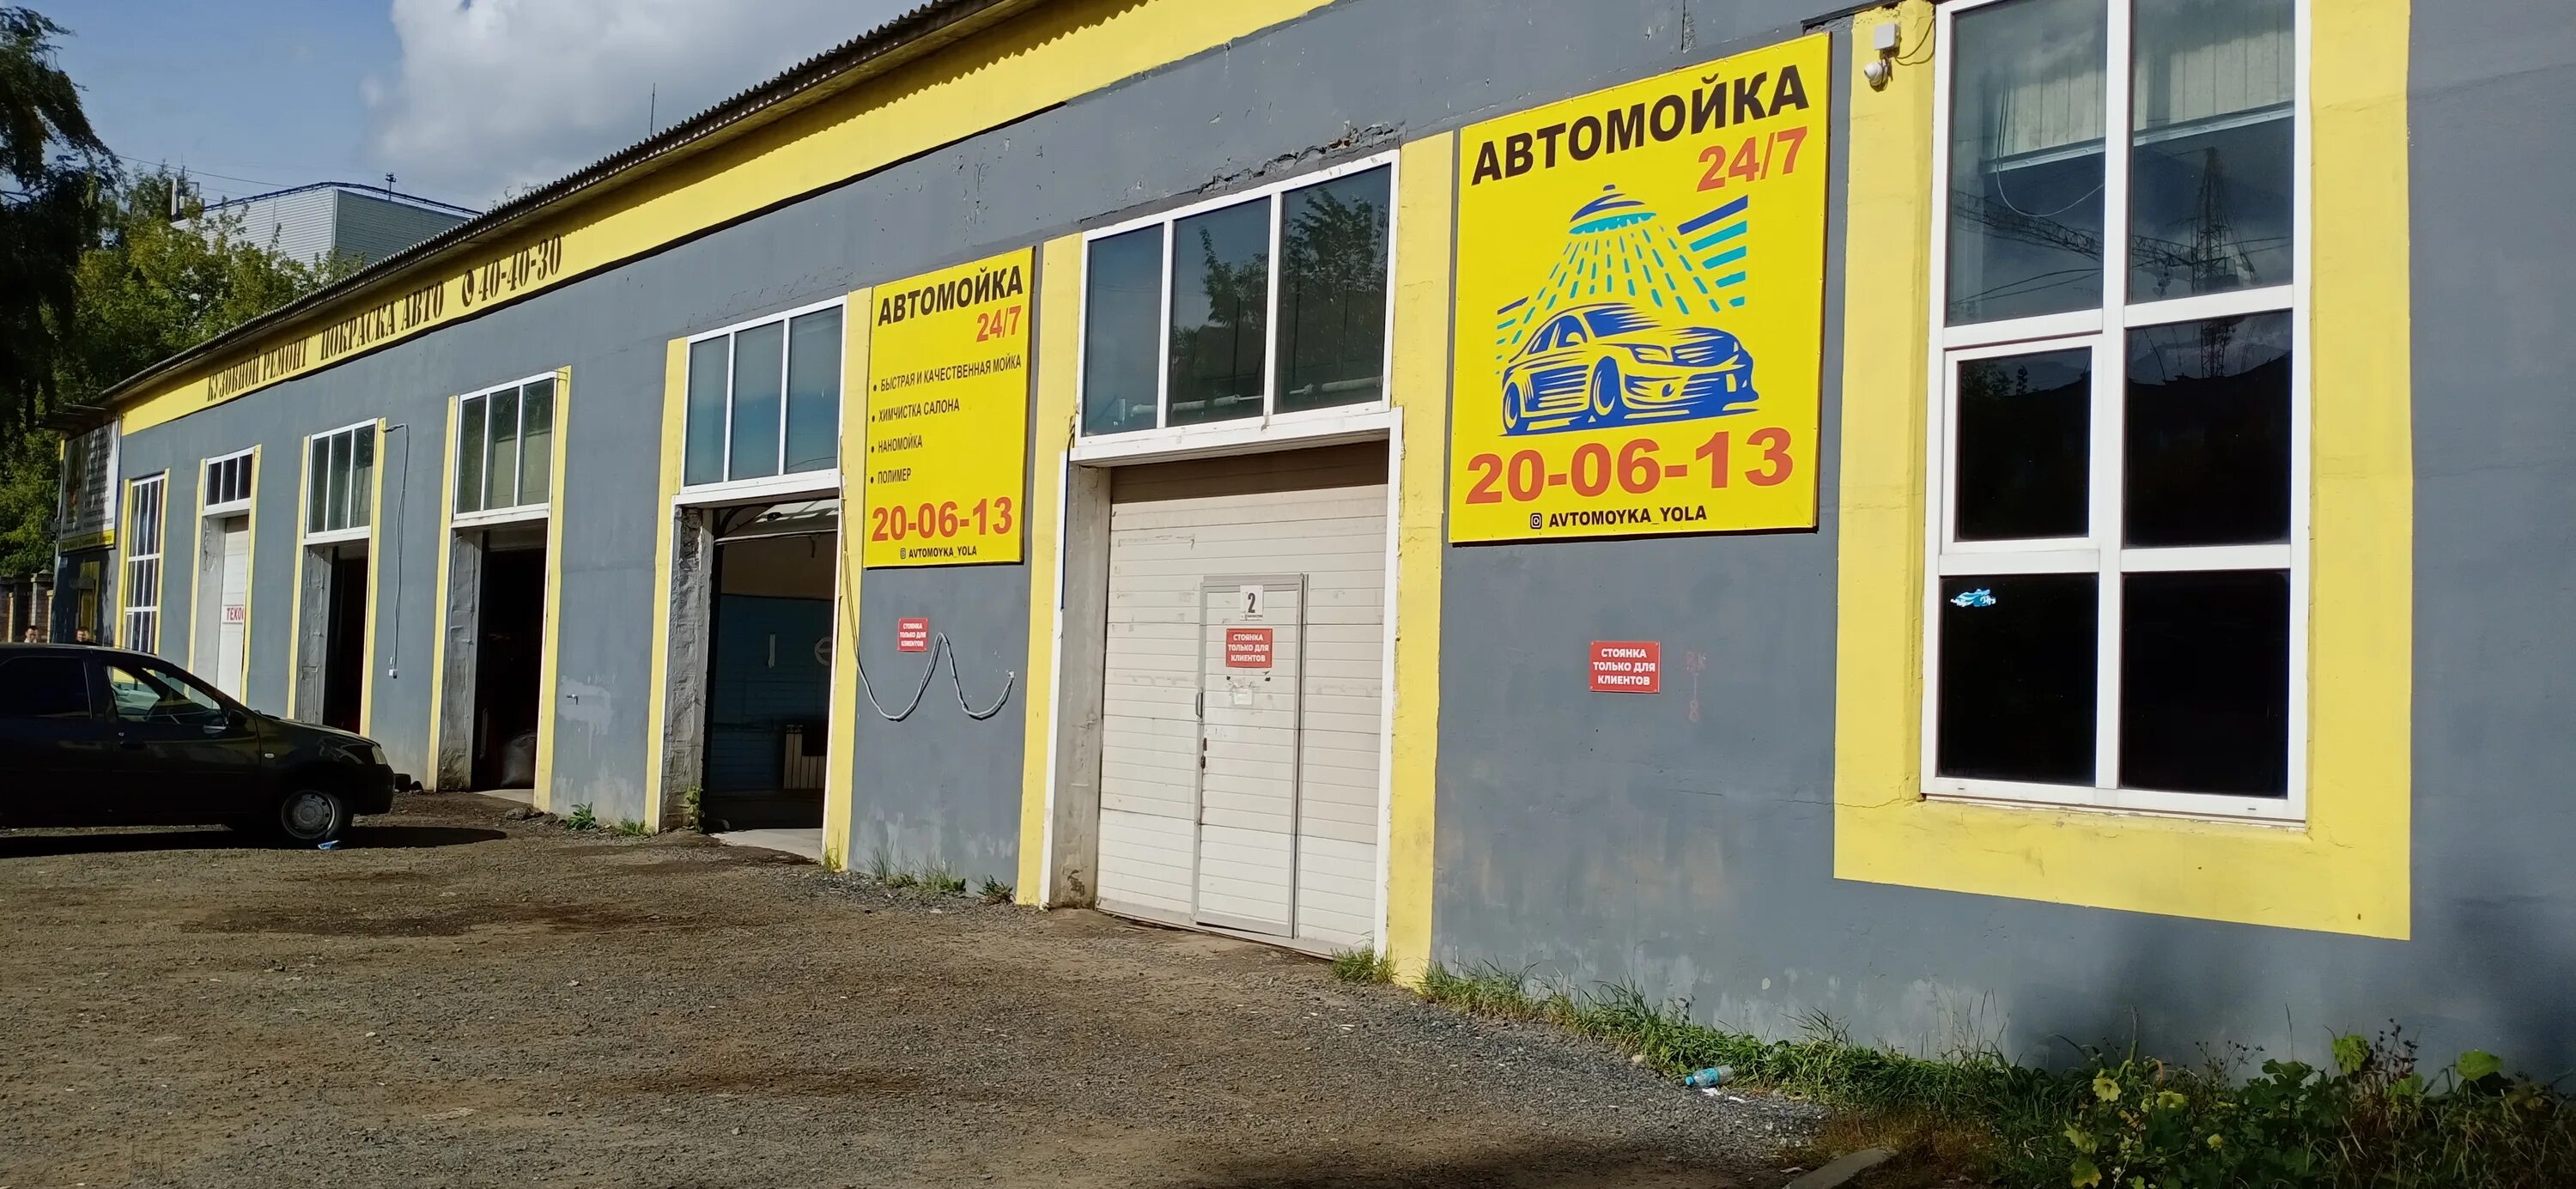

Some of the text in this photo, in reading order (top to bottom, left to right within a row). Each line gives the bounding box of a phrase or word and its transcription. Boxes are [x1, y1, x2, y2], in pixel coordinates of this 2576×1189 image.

[1471, 64, 1809, 185] АВТОМОЙКА
[1696, 126, 1809, 191] 24/7
[878, 265, 1023, 326] АВТОМОЙКА
[207, 234, 562, 402] КУЗОВНОЙ РЕМОНТ ПОКРАСКА АВТО 40-40-30
[976, 306, 1022, 343] 24/7
[881, 354, 1022, 391] БЫСТРАЯ И КАЧЕСТВЕННАЯ МОЙКА
[878, 398, 960, 422] ХИМЧИСТКА САЛОНА
[878, 433, 923, 453] НАНОМОЙКА
[878, 468, 912, 484] ПОЛИМЕР
[1465, 427, 1794, 505] 20-06-13
[872, 496, 1012, 542] 20-06-13
[1248, 592, 1256, 613] 2
[1255, 644, 1269, 652] ДЛЯ
[1601, 648, 1647, 658] СТОЯНКА
[1593, 661, 1656, 673] ТОЛЬКО ДЛЯ
[1597, 675, 1650, 686] КЛИЕНТОВ
